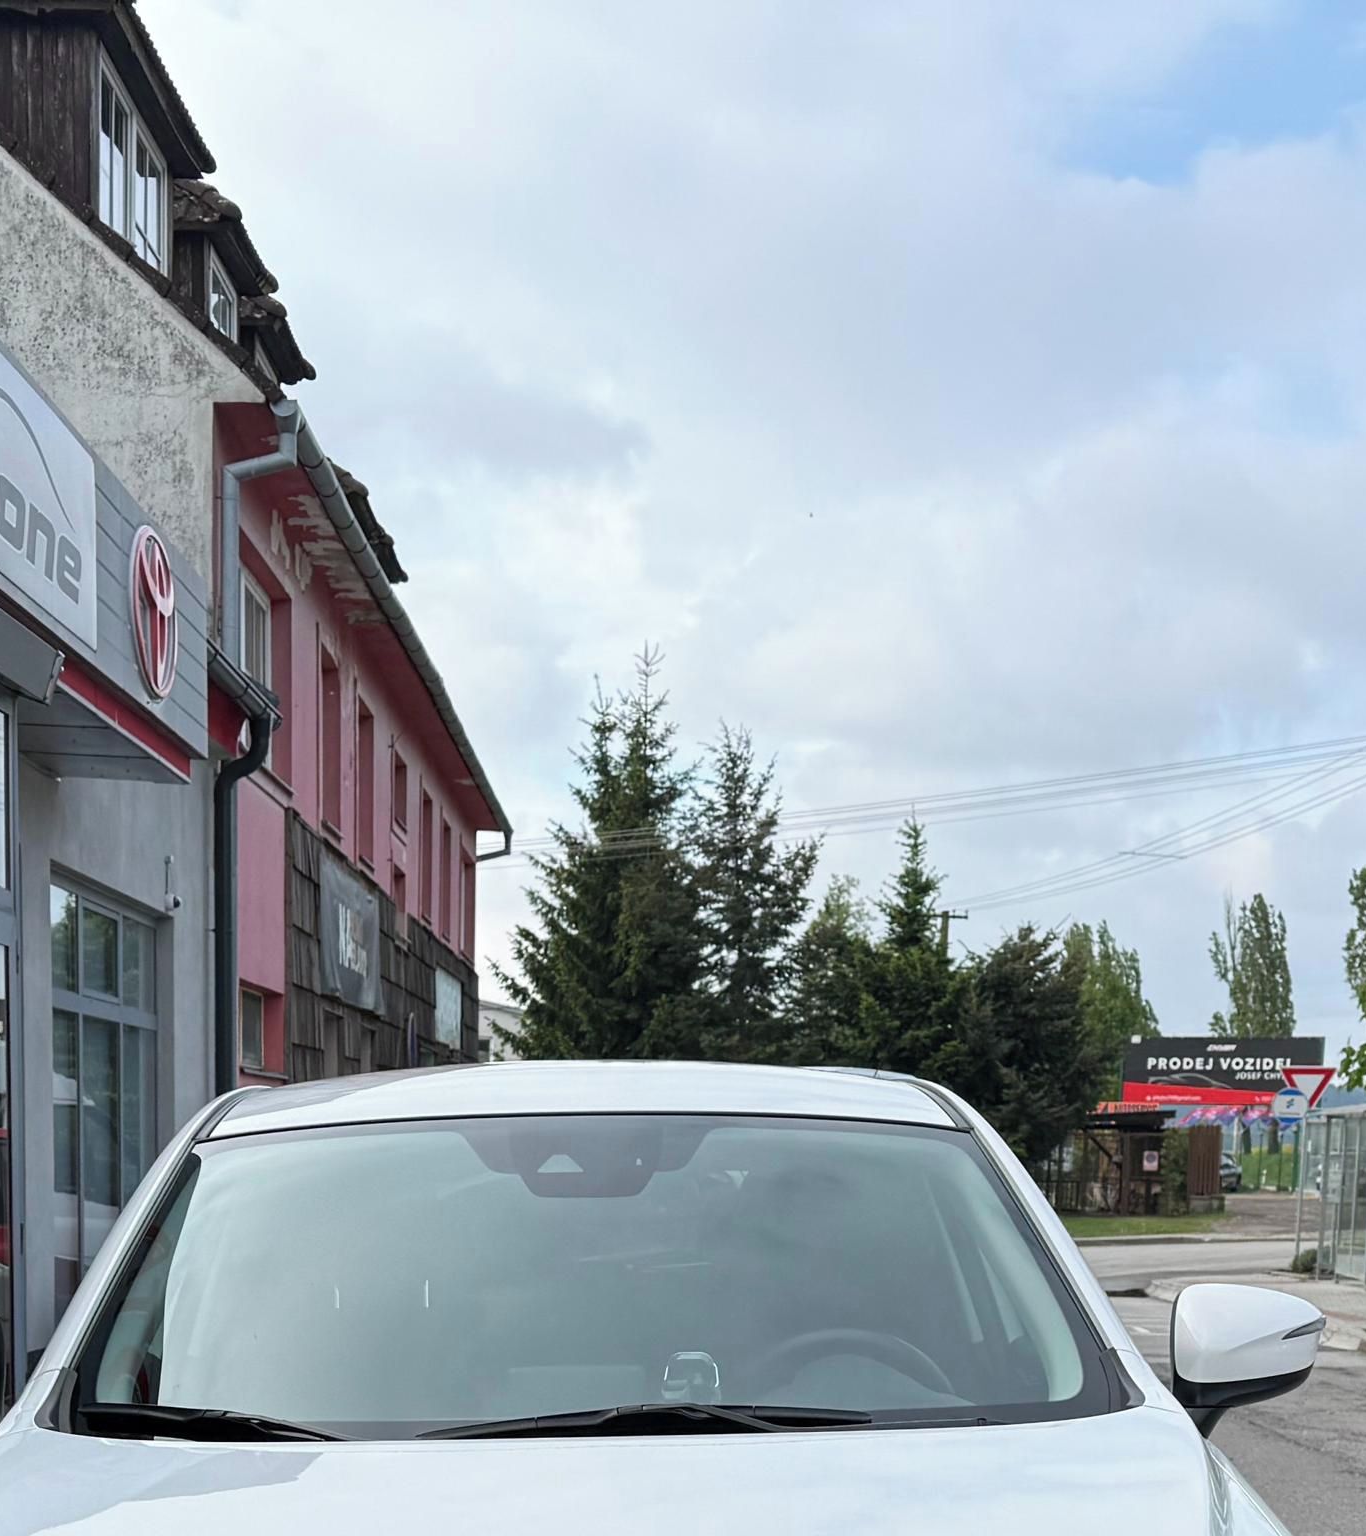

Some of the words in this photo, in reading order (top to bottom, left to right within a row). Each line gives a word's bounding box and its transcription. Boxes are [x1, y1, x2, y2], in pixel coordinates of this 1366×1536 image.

[1147, 1057, 1213, 1070] PRODEJ
[1235, 1071, 1262, 1080] JOSEF
[1264, 1071, 1284, 1080] CHY
